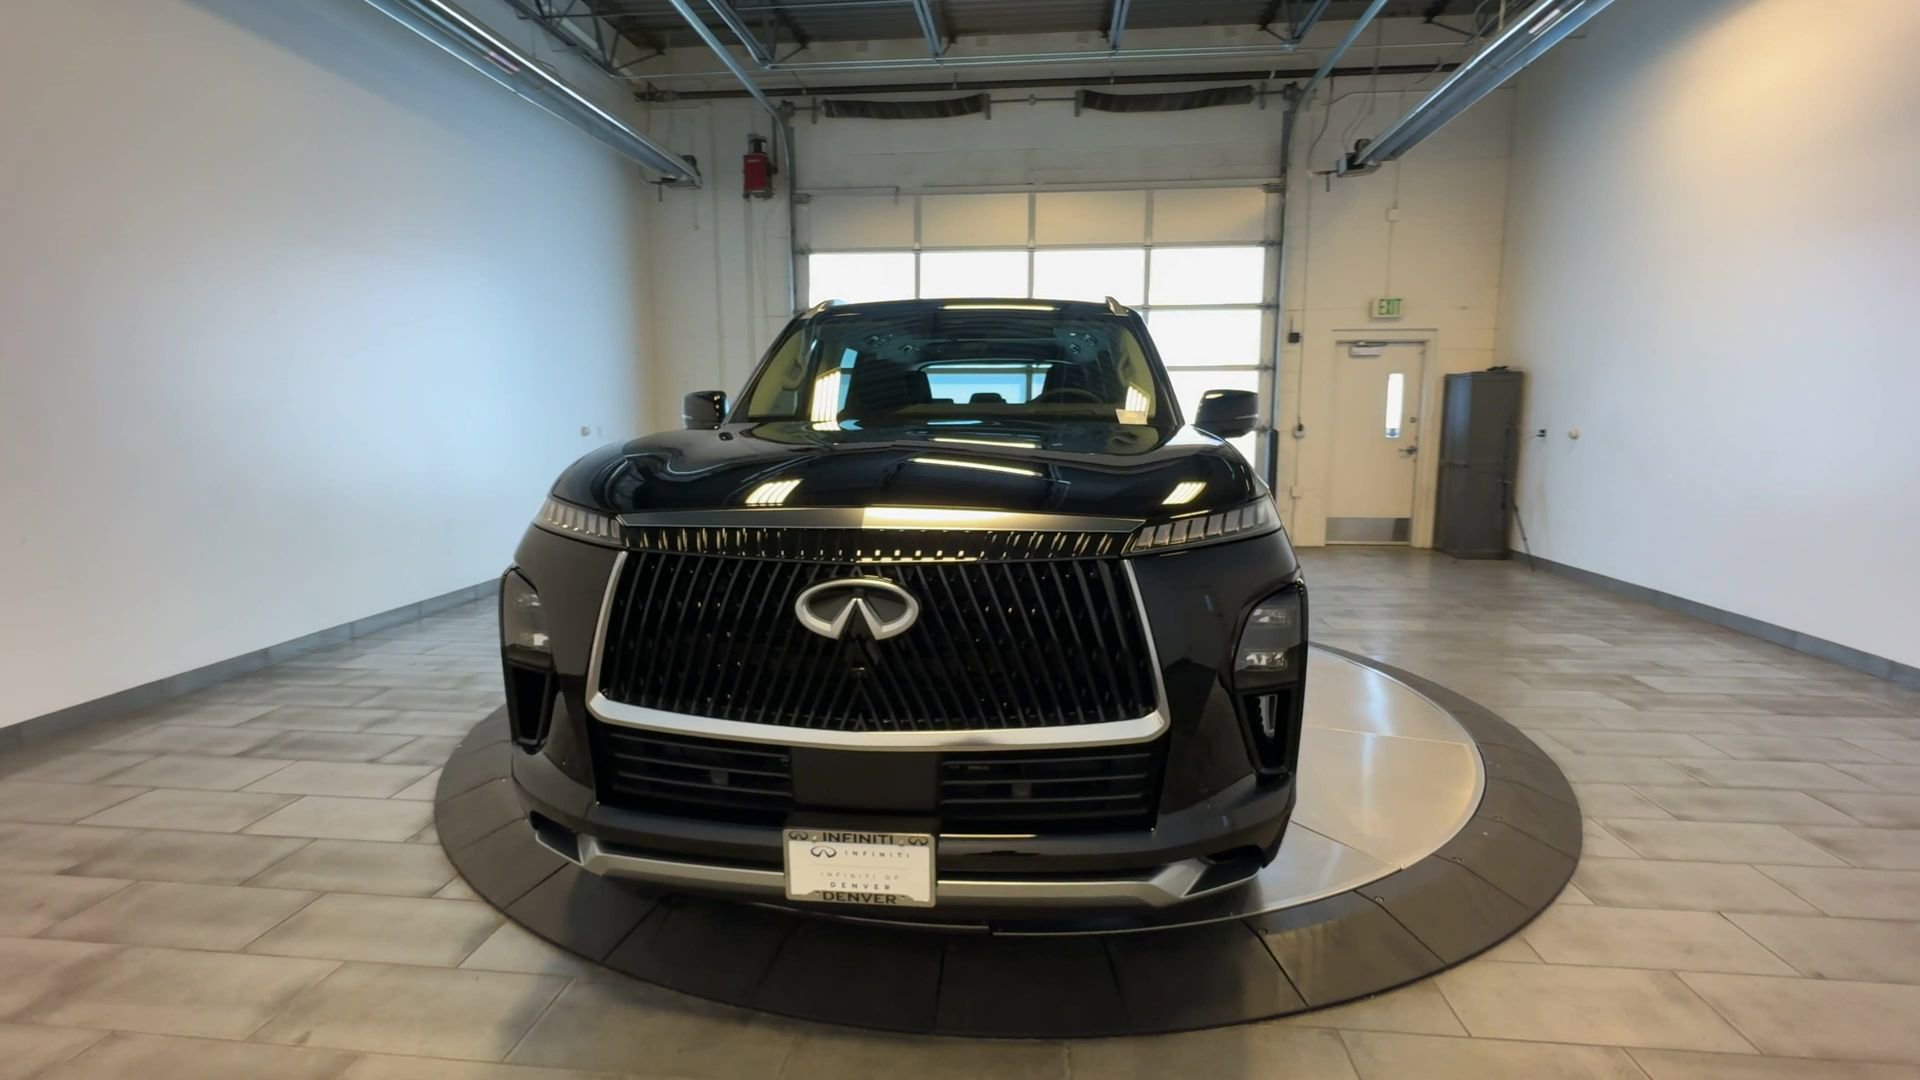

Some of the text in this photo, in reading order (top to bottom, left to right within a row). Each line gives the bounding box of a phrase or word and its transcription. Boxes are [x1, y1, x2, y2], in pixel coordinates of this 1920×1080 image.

[1378, 298, 1402, 316] EXIT
[823, 832, 894, 845] INFINITI
[844, 850, 910, 859] INFINITI
[820, 871, 876, 880] INFINITI
[830, 881, 891, 891] DENVER
[822, 891, 897, 905] DENVER
